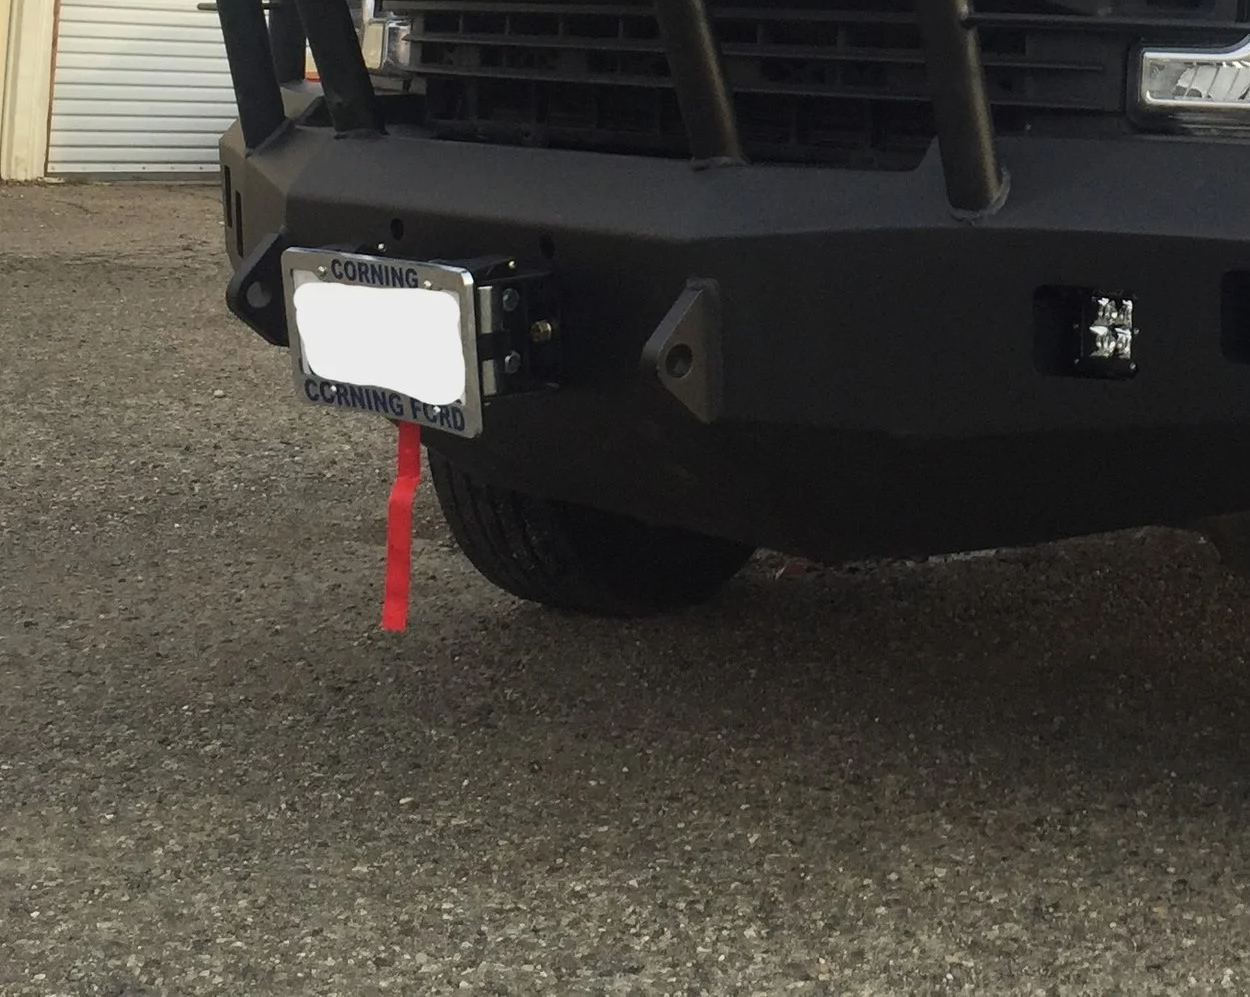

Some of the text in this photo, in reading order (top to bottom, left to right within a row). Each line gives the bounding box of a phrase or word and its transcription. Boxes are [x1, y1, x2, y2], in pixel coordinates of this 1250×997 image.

[331, 258, 419, 289] CORNING
[304, 378, 466, 432] CORNING FORD
